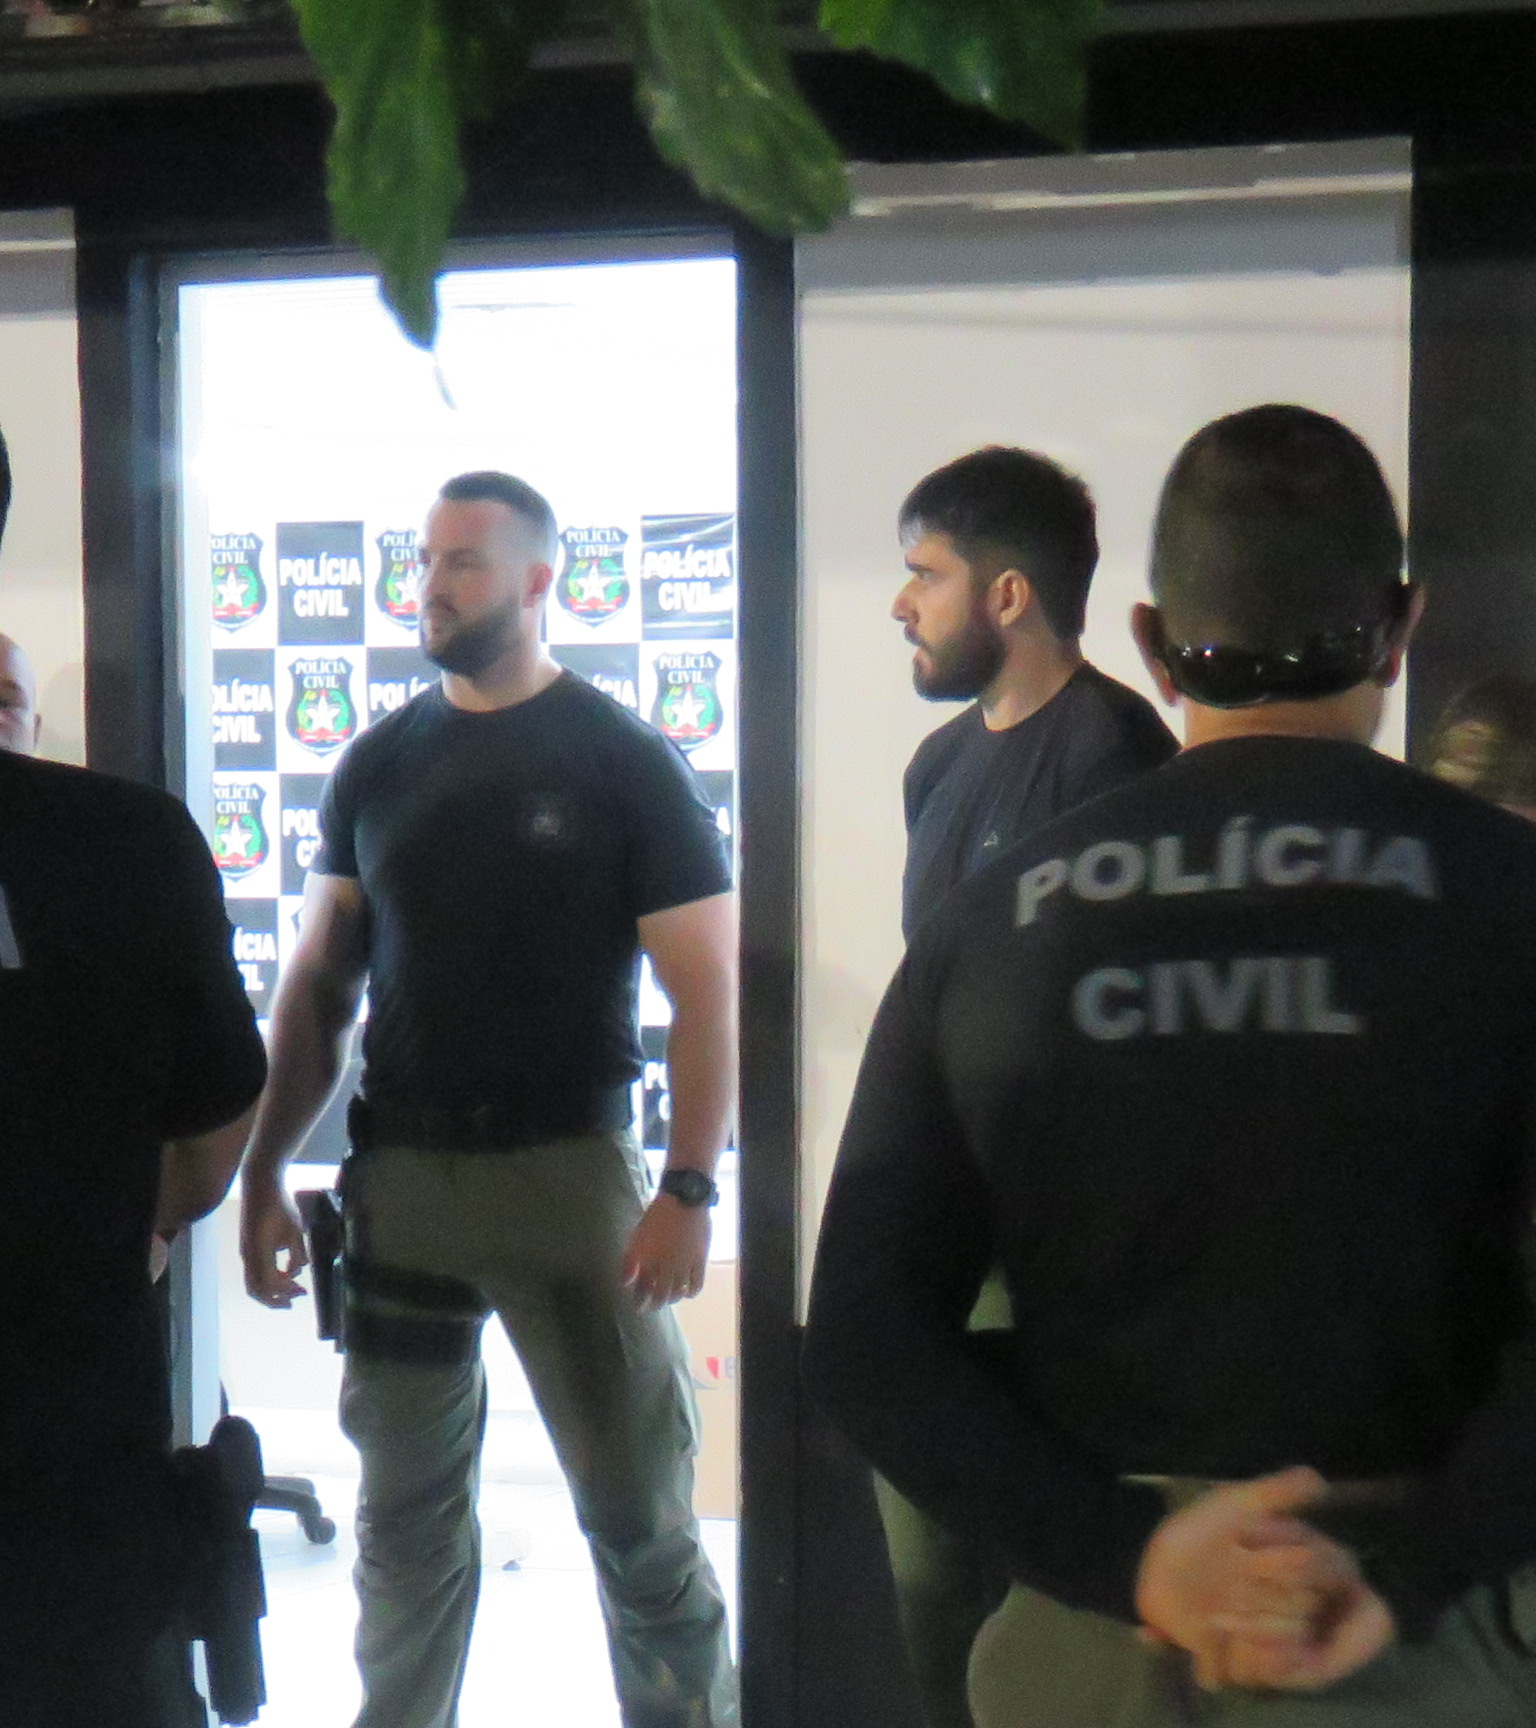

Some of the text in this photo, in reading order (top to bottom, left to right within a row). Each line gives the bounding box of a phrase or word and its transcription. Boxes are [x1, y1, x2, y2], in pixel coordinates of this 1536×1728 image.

[575, 544, 613, 559] CIVIL
[643, 543, 731, 580] POLÍCIA
[279, 551, 362, 587] POLÍCIA
[293, 588, 349, 618] CIVIL
[658, 581, 719, 612] CIVIL
[302, 675, 341, 689] CIVIL
[667, 669, 706, 684] CIVIL
[216, 800, 251, 815] CIVIL
[1014, 814, 1442, 930] POLÍCIA
[232, 926, 277, 961] ÍCIA
[1071, 956, 1364, 1041] CIVIL
